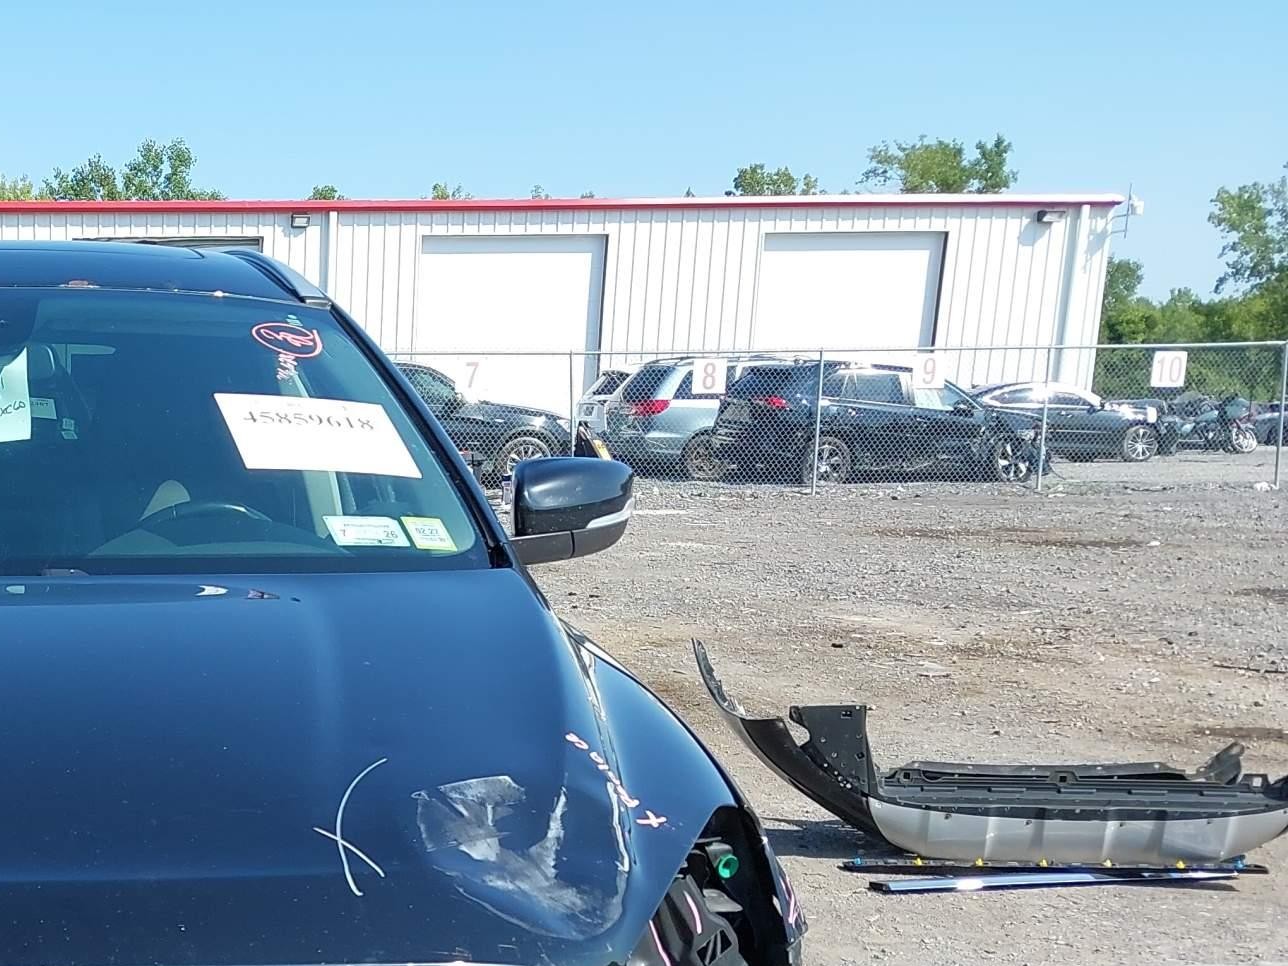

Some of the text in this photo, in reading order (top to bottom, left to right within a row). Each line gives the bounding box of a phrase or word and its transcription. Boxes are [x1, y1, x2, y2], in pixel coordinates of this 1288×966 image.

[465, 361, 480, 389] 7
[702, 362, 716, 390] 8
[922, 357, 936, 385] 9
[1157, 355, 1183, 383] 10
[243, 411, 375, 431] 45859618
